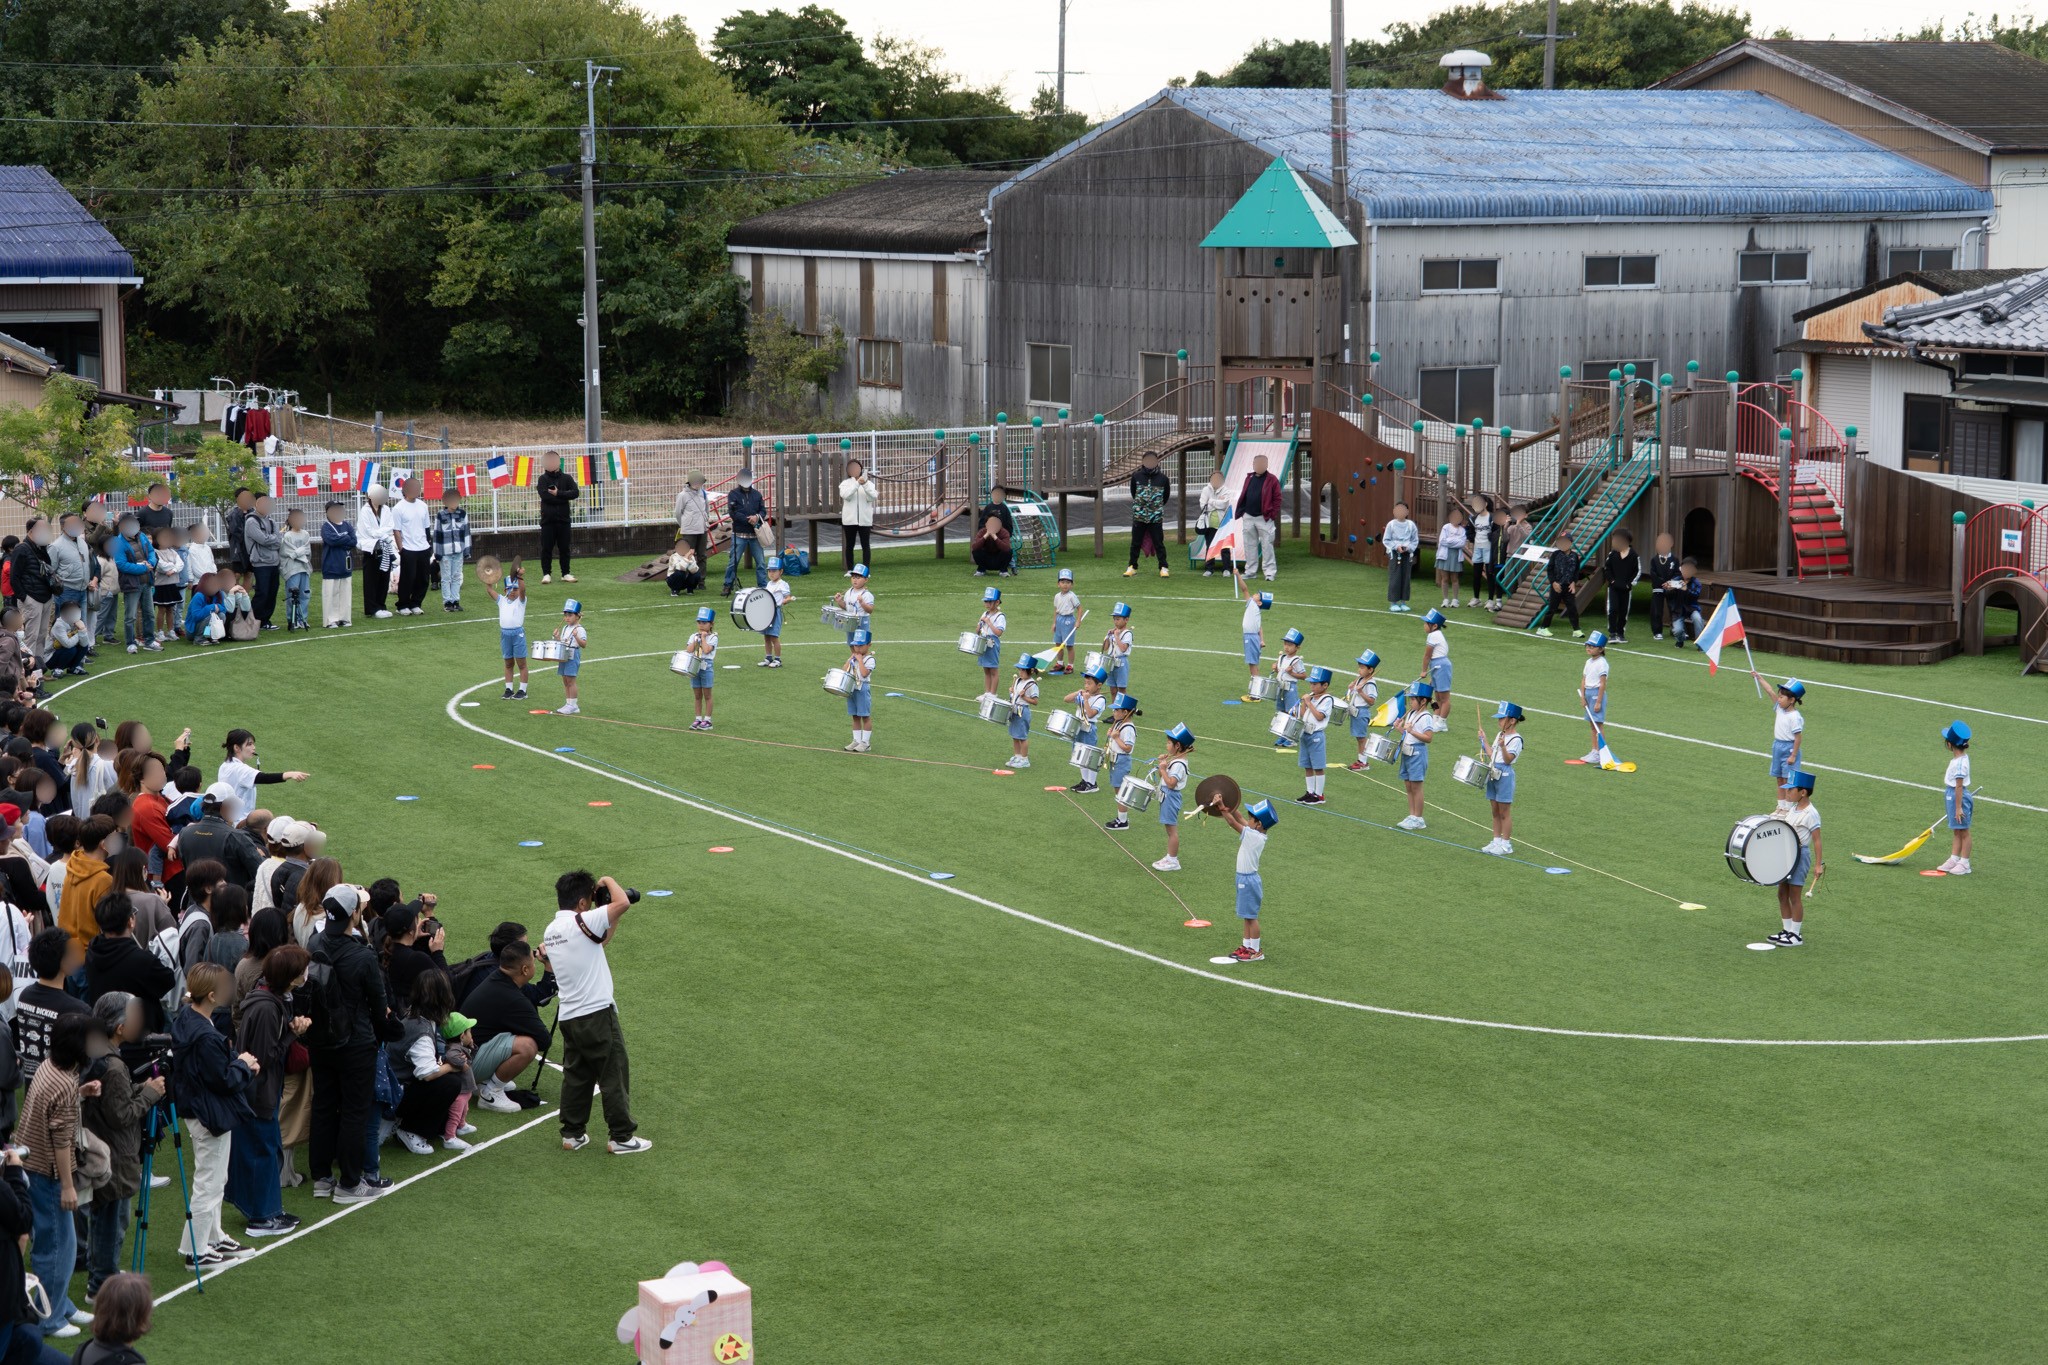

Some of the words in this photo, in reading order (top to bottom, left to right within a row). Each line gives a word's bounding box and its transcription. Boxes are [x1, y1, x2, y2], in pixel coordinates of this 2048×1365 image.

[1756, 827, 1781, 840] KAWAI
[579, 922, 593, 937] Canon
[36, 1006, 59, 1019] DICKIES
